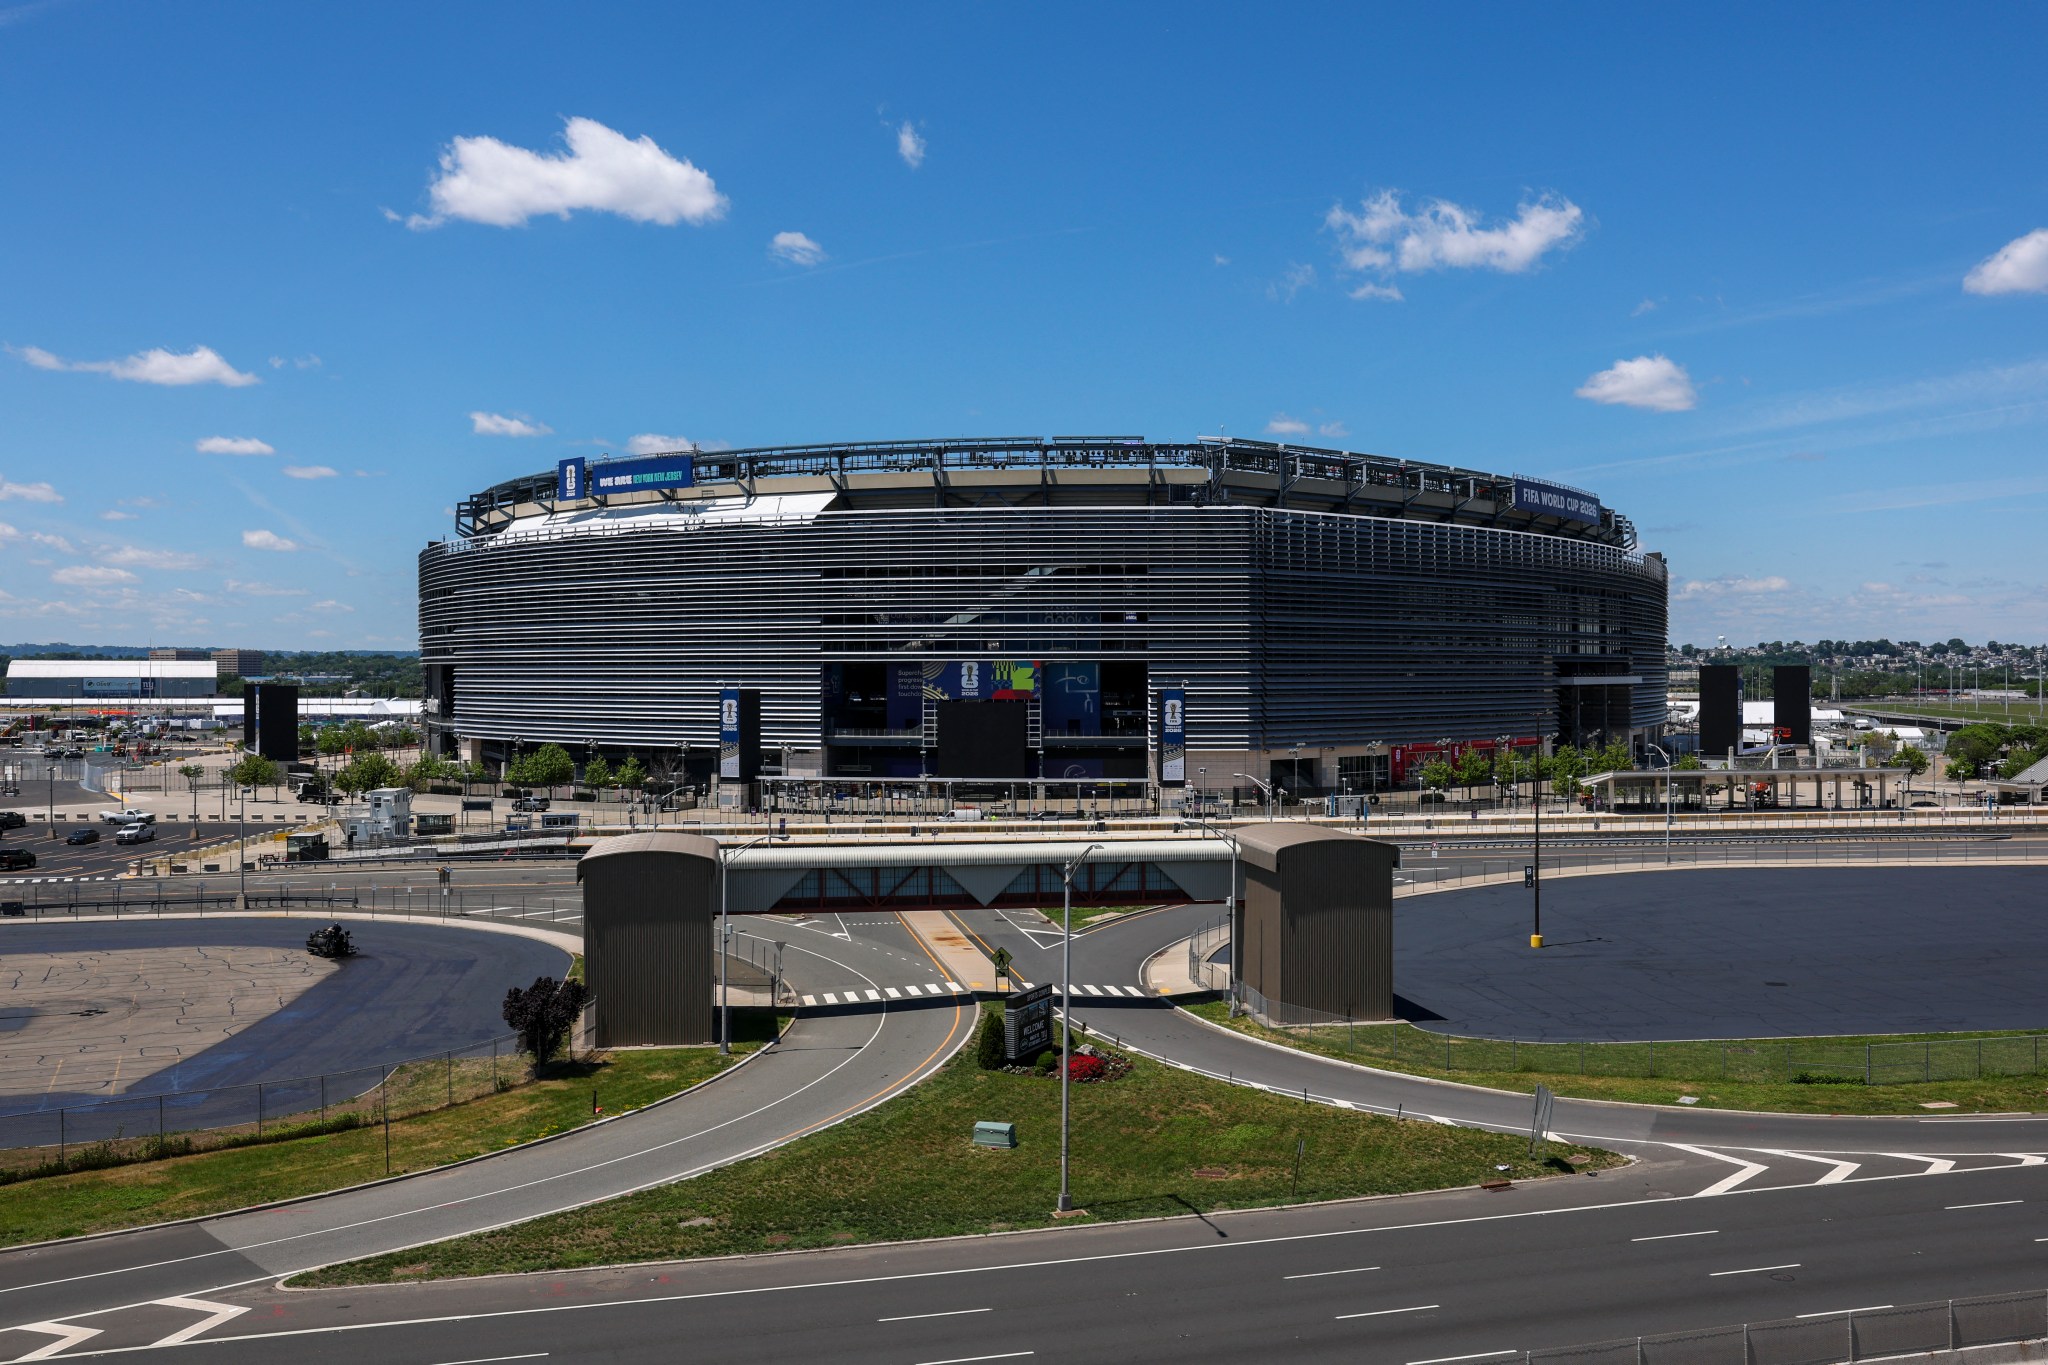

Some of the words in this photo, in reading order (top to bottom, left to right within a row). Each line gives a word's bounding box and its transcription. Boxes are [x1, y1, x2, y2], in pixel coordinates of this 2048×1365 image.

[600, 477, 613, 487] WE
[614, 475, 632, 485] ARE
[633, 474, 643, 484] NEW
[643, 473, 654, 483] YORK
[654, 472, 665, 482] NEW
[665, 470, 683, 481] JERSEY
[1523, 488, 1540, 504] FIFA
[1541, 491, 1565, 509] WORLD
[1566, 497, 1579, 511] CUP
[1580, 500, 1597, 517] 2026
[1526, 867, 1532, 875] B
[1023, 1020, 1044, 1036] WELCOME
